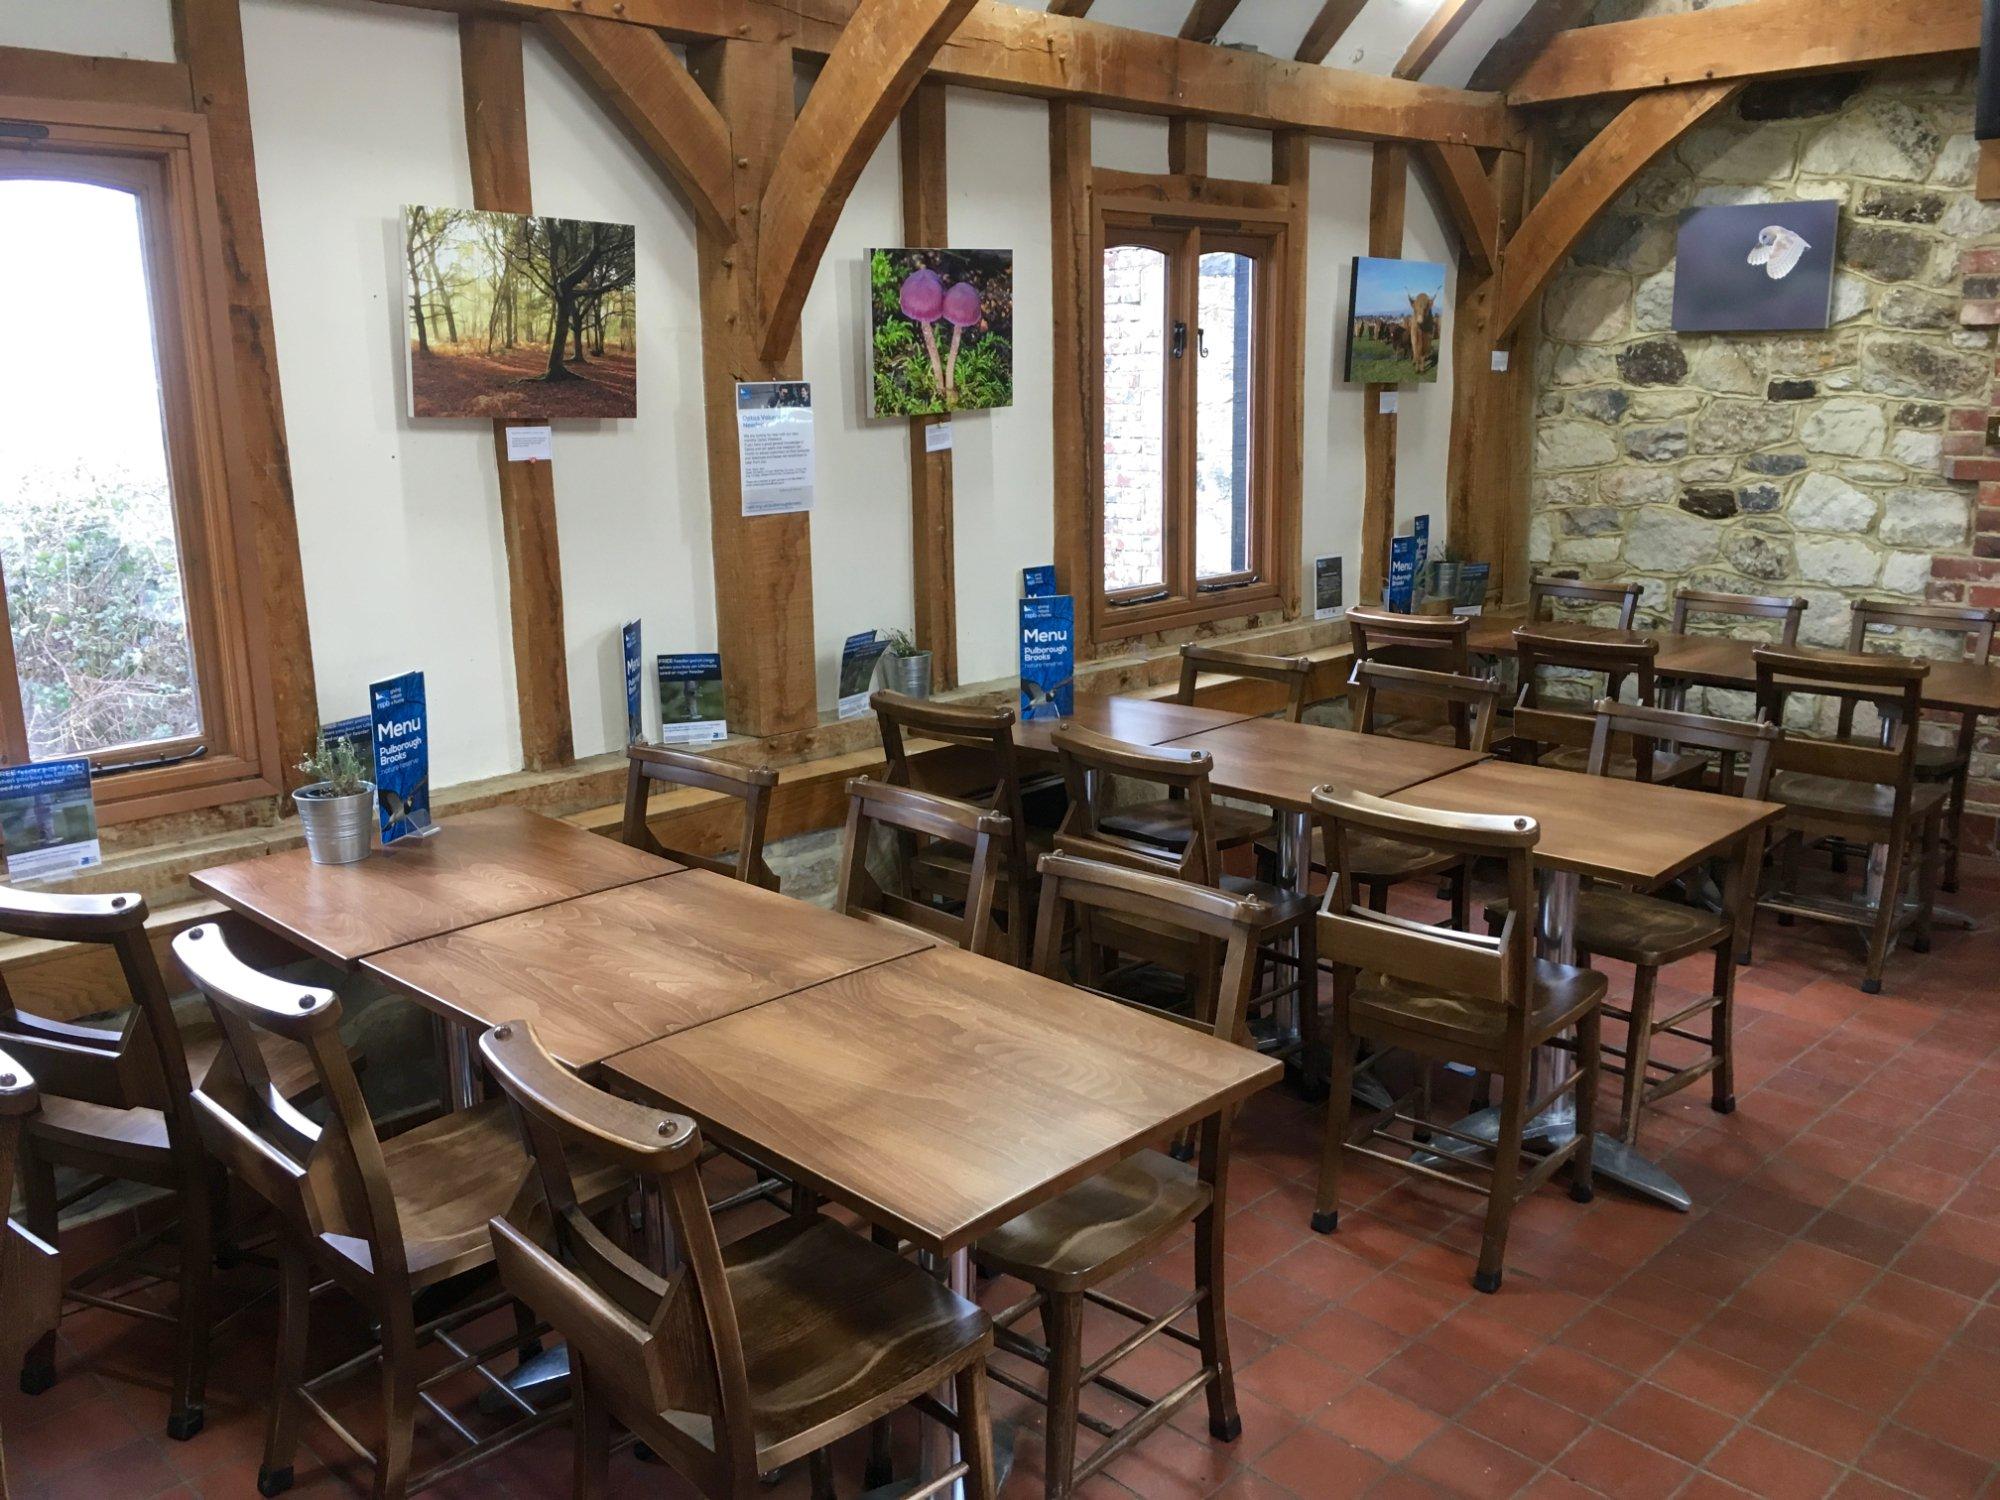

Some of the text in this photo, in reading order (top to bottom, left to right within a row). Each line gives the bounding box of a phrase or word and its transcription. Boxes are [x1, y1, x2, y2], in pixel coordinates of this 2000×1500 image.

[1392, 560, 1413, 572] Menu
[1024, 628, 1067, 643] Menu
[1024, 645, 1067, 655] Pulborough
[1024, 653, 1051, 662] Brooks
[377, 700, 390, 709] rspb
[378, 717, 421, 742] Menu
[380, 737, 422, 757] Pulborough
[380, 751, 407, 766] Brooks
[380, 764, 399, 775] nature
